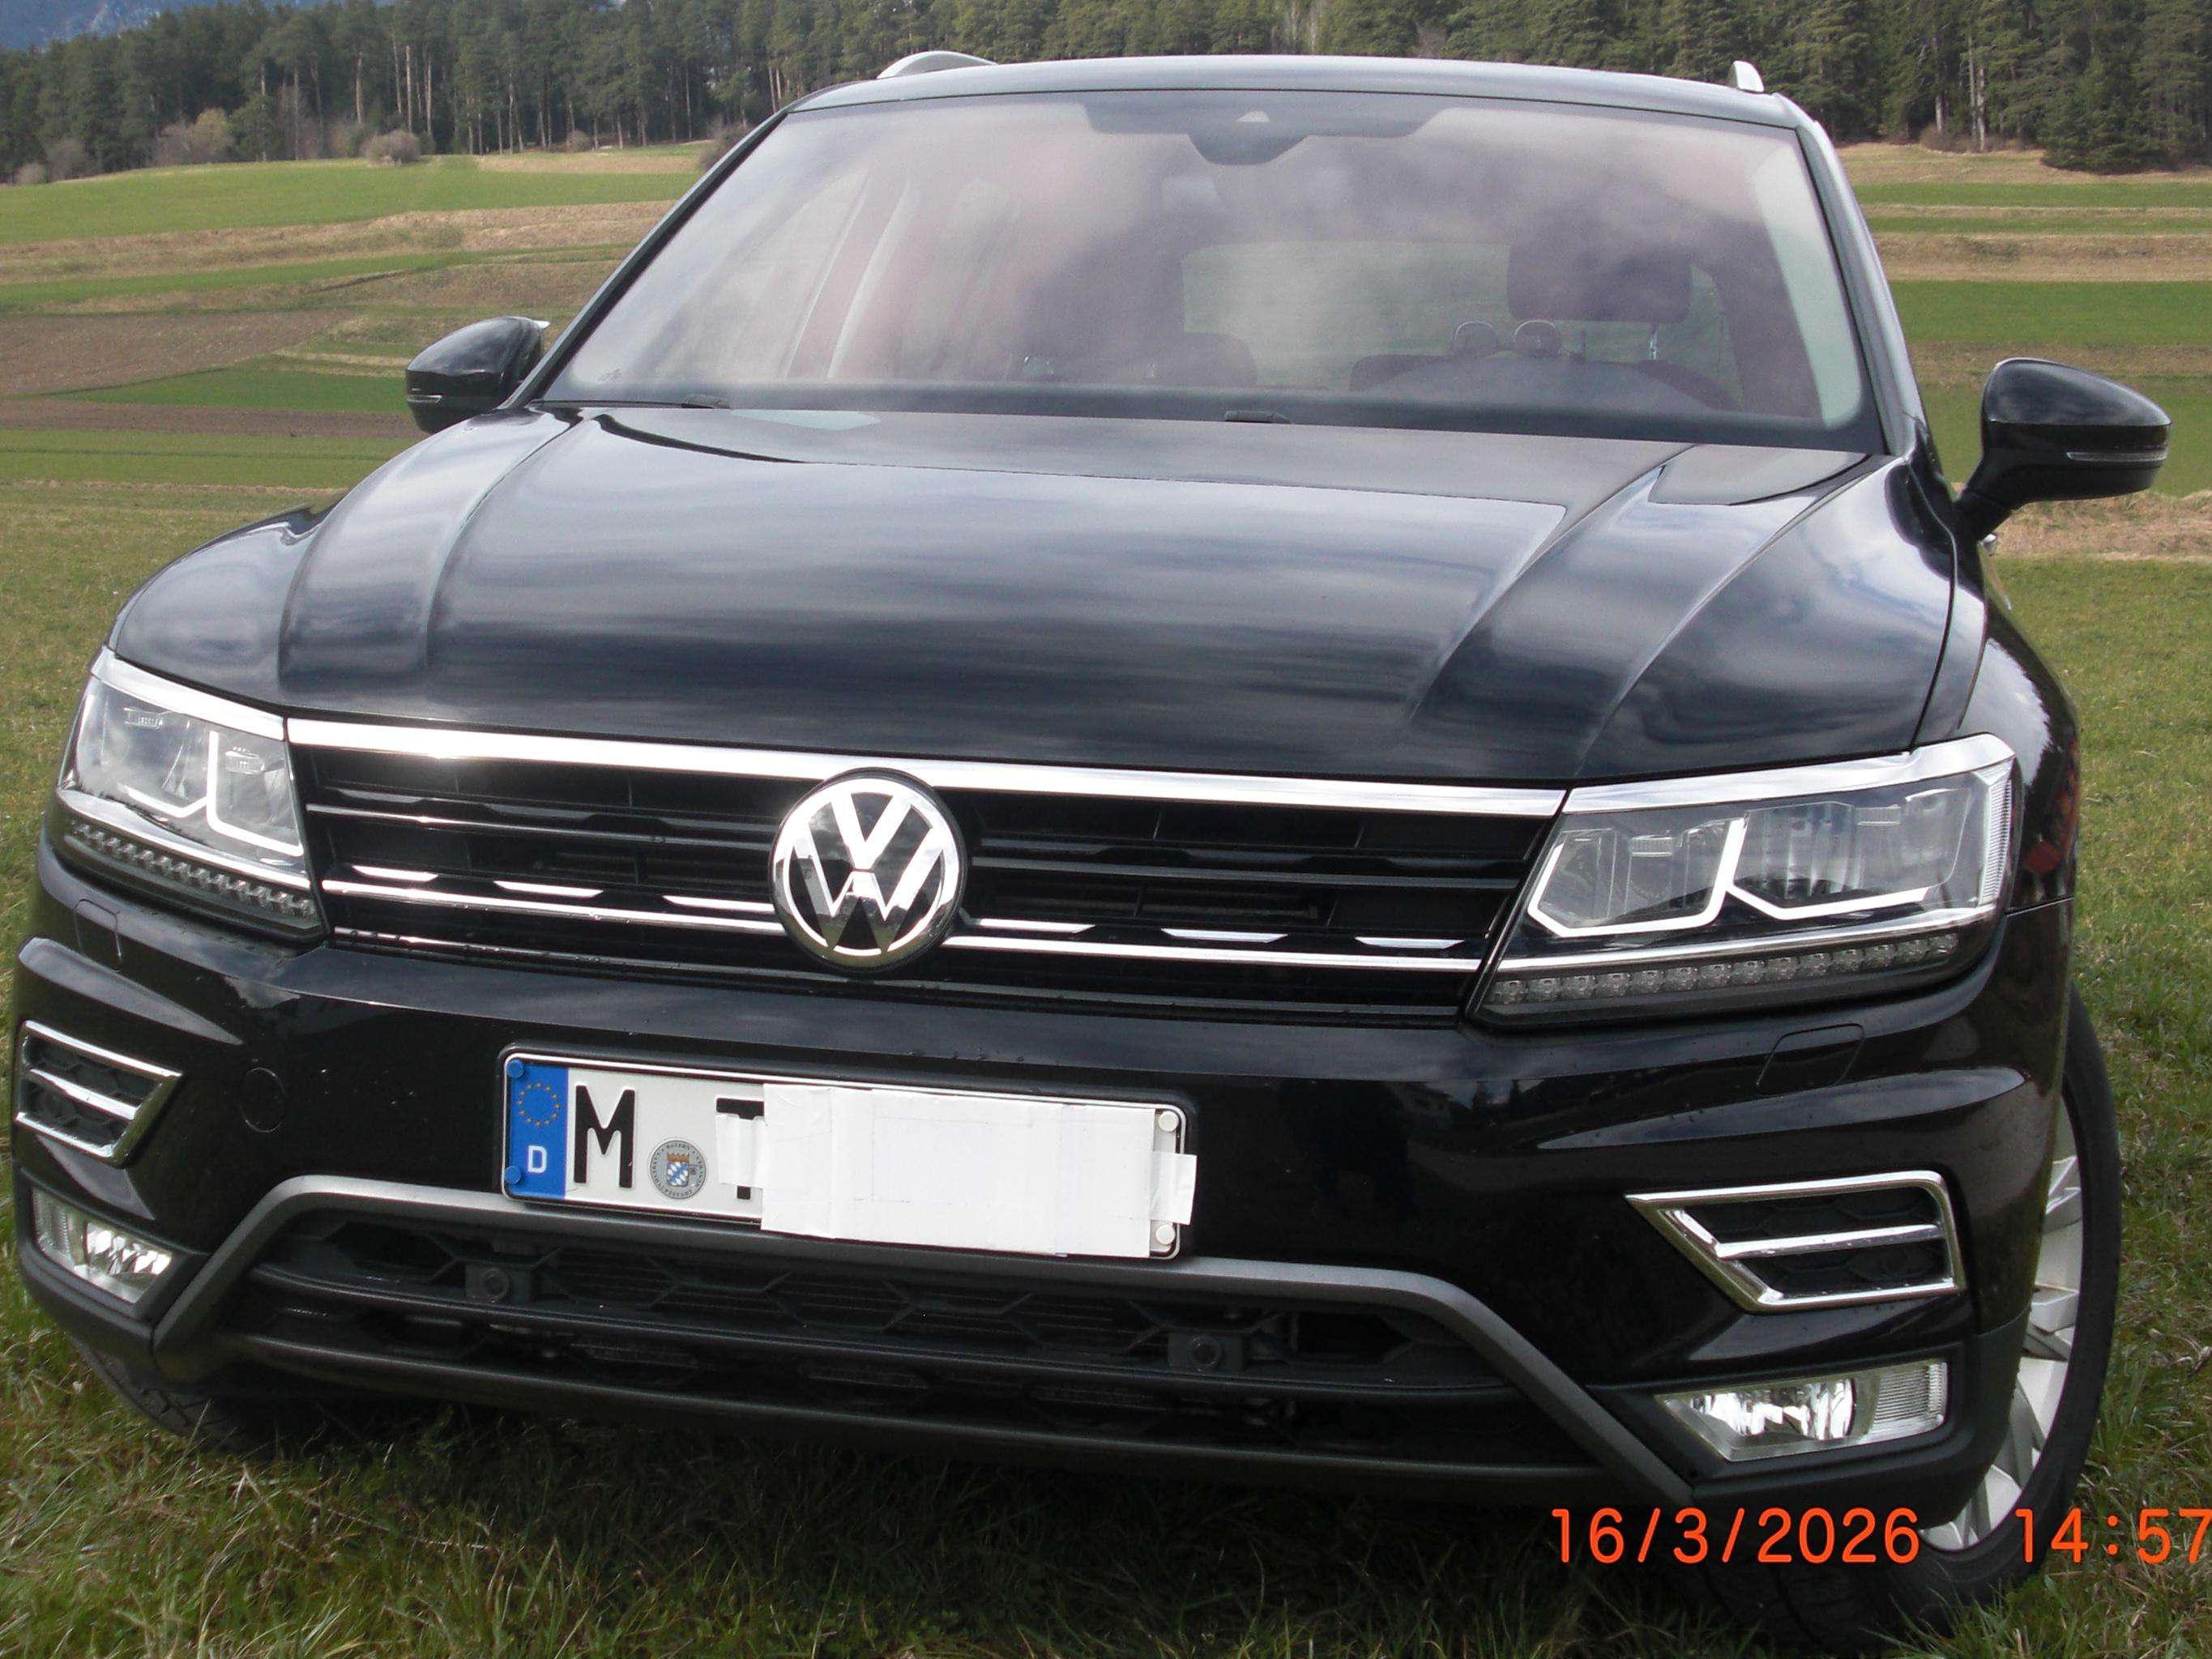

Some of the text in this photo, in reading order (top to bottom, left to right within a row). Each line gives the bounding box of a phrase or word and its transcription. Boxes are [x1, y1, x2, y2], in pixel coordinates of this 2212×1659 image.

[780, 783, 951, 954] VW
[527, 1145, 547, 1173] D
[574, 1085, 635, 1188] M
